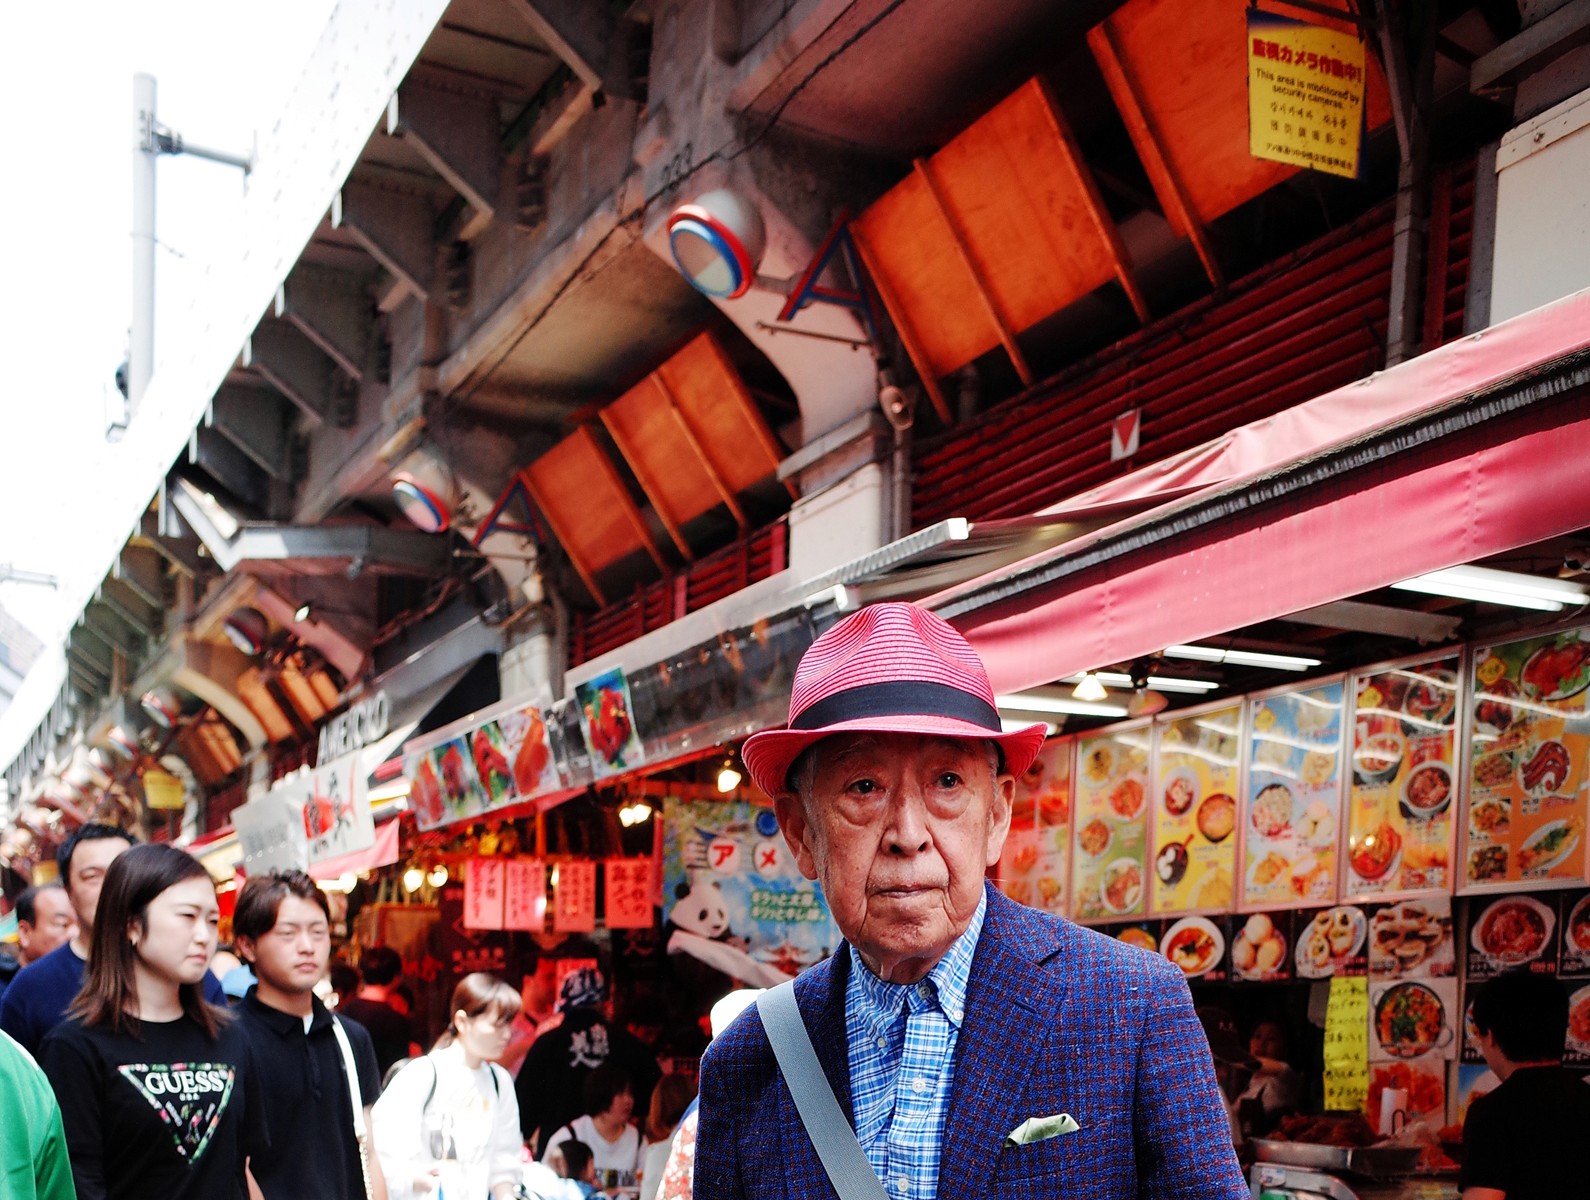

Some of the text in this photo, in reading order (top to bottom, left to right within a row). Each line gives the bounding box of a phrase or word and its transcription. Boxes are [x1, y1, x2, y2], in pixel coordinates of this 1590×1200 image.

[1256, 68, 1359, 105] This area is monitored by
[1273, 86, 1305, 101] security
[145, 1070, 225, 1095] GUESS
